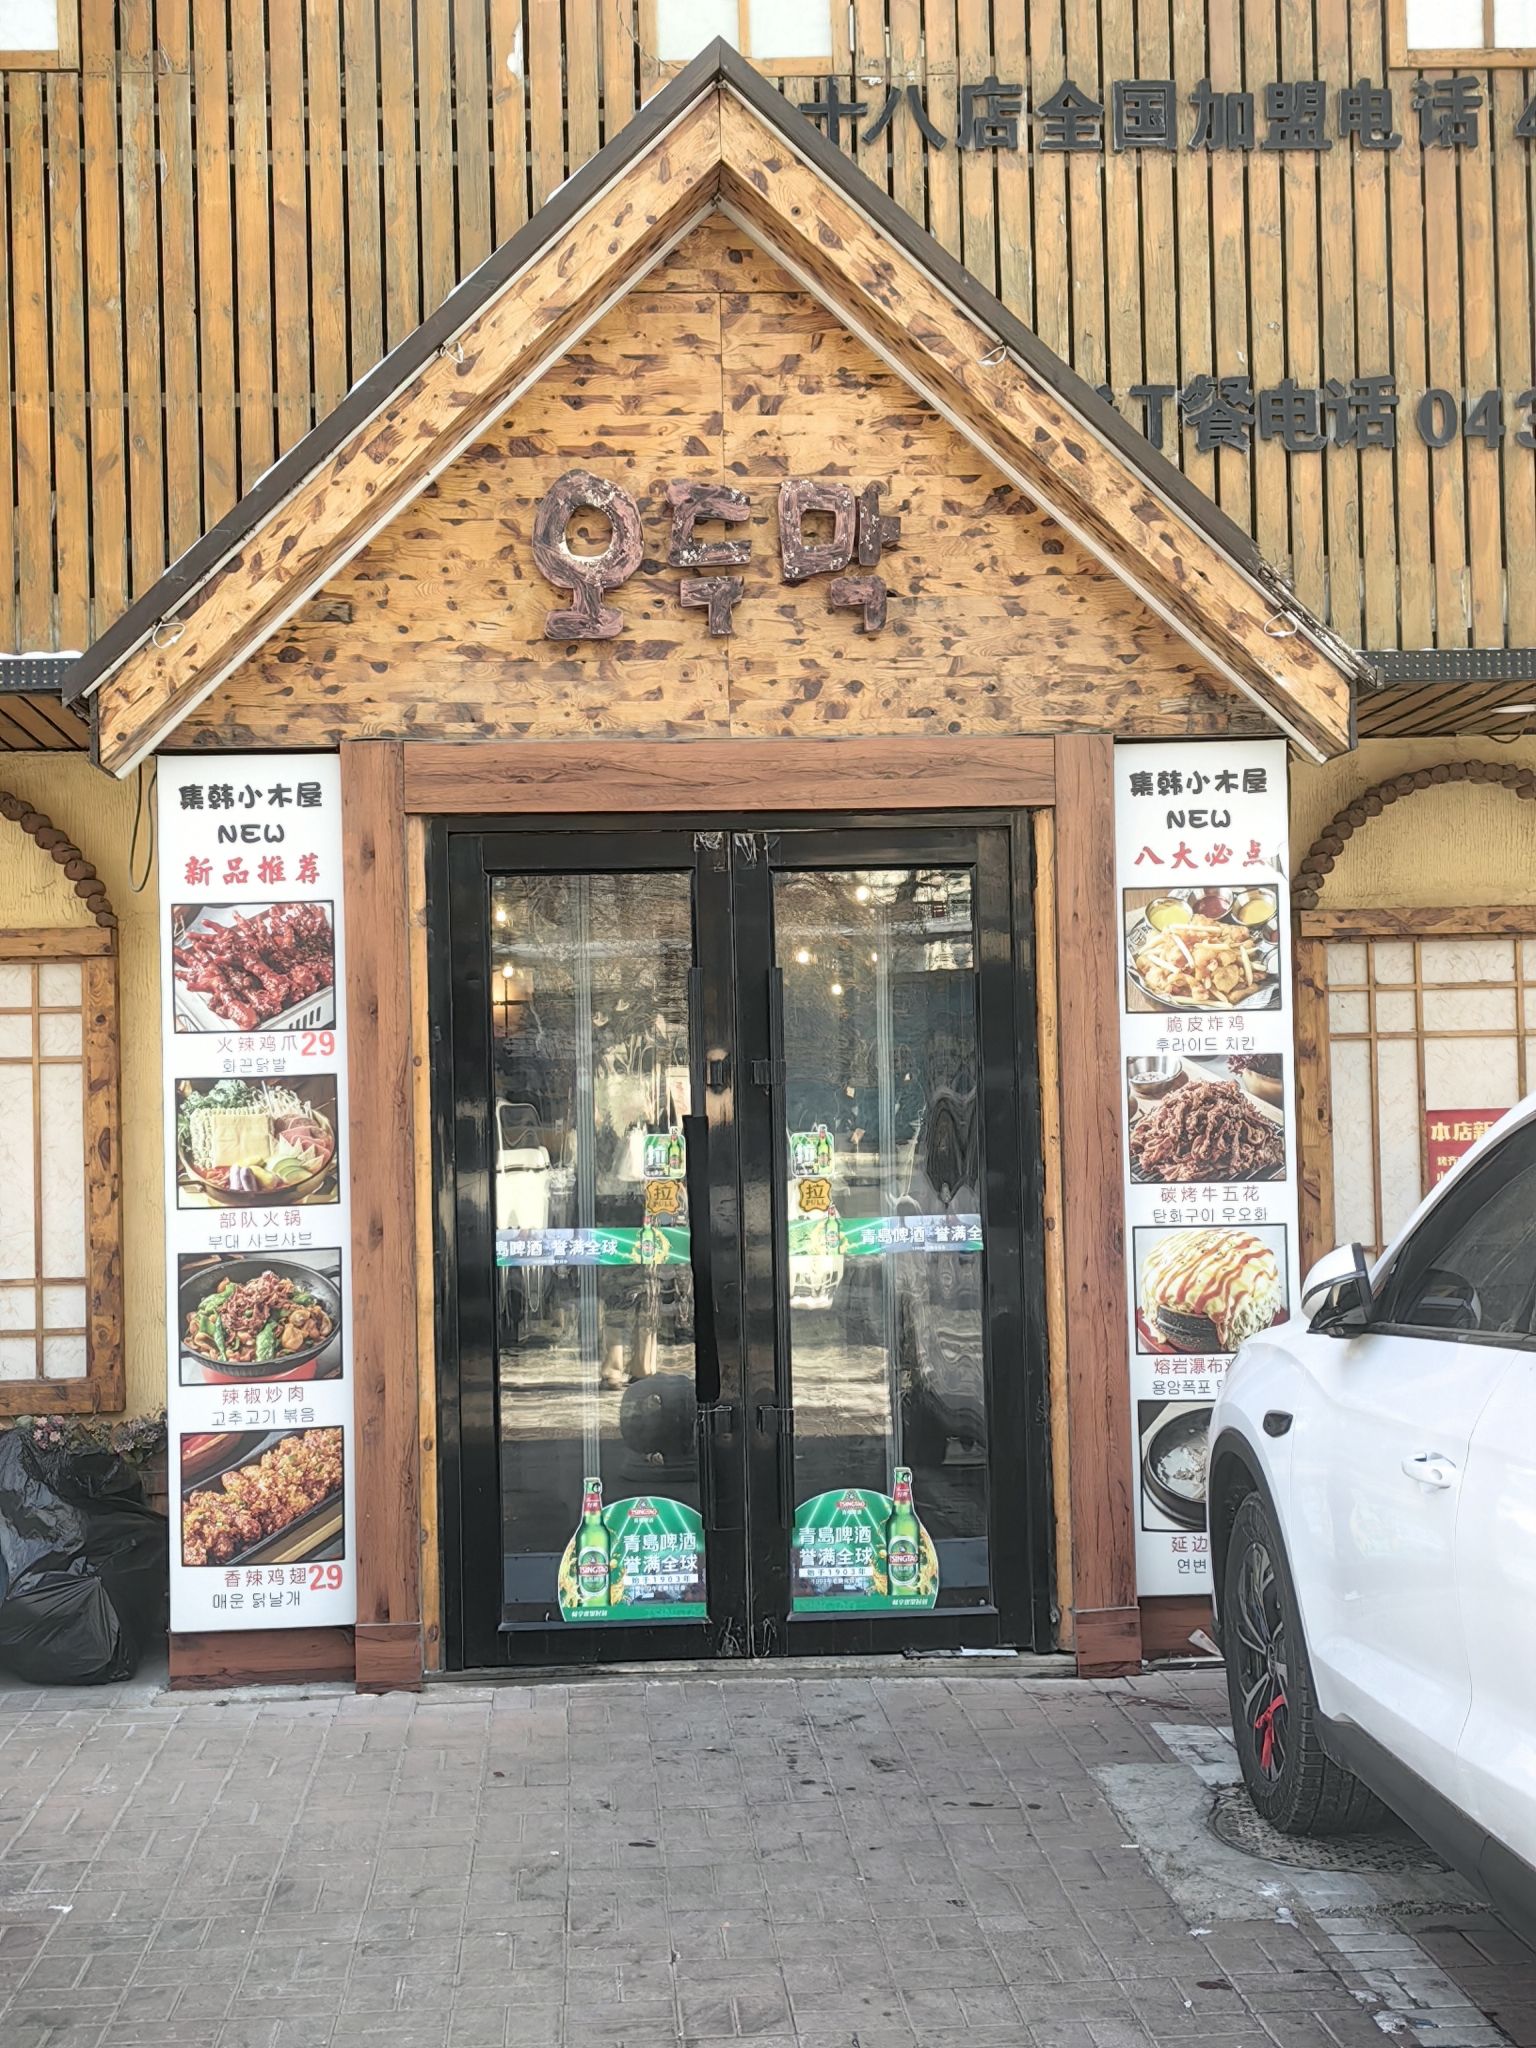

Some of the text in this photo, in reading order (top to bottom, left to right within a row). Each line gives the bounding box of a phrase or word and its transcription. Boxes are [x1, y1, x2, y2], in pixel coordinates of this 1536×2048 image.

[532, 468, 900, 640] 오두막
[1166, 809, 1231, 829] NEW
[217, 824, 285, 844] NEW
[1134, 839, 1266, 869] 八大必点
[184, 853, 320, 886] 新品推荐
[1166, 1016, 1245, 1033] 脆皮炸鸡
[217, 1030, 336, 1056] 火辣鸡爪 29
[1225, 1036, 1255, 1051] 치킨
[654, 1185, 673, 1200] 拉
[806, 1184, 824, 1199] 拉
[1161, 1185, 1260, 1203] 碳烤牛五花
[219, 1209, 302, 1229] 部队火锅
[208, 1233, 239, 1250] 부대
[222, 1385, 304, 1406] 辣椒炒肉
[211, 1407, 316, 1426] 고추고기 볶음
[1171, 1535, 1209, 1553] 延边
[624, 1554, 698, 1574] 誉满全球
[799, 1548, 873, 1567] 誉满全球
[889, 1555, 918, 1564] TSINGTAO
[1177, 1558, 1207, 1574] 연변
[224, 1564, 343, 1590] 香辣鸡翅 29
[580, 1565, 609, 1575] TSINGTAO
[212, 1590, 301, 1609] 매운 닭날개
